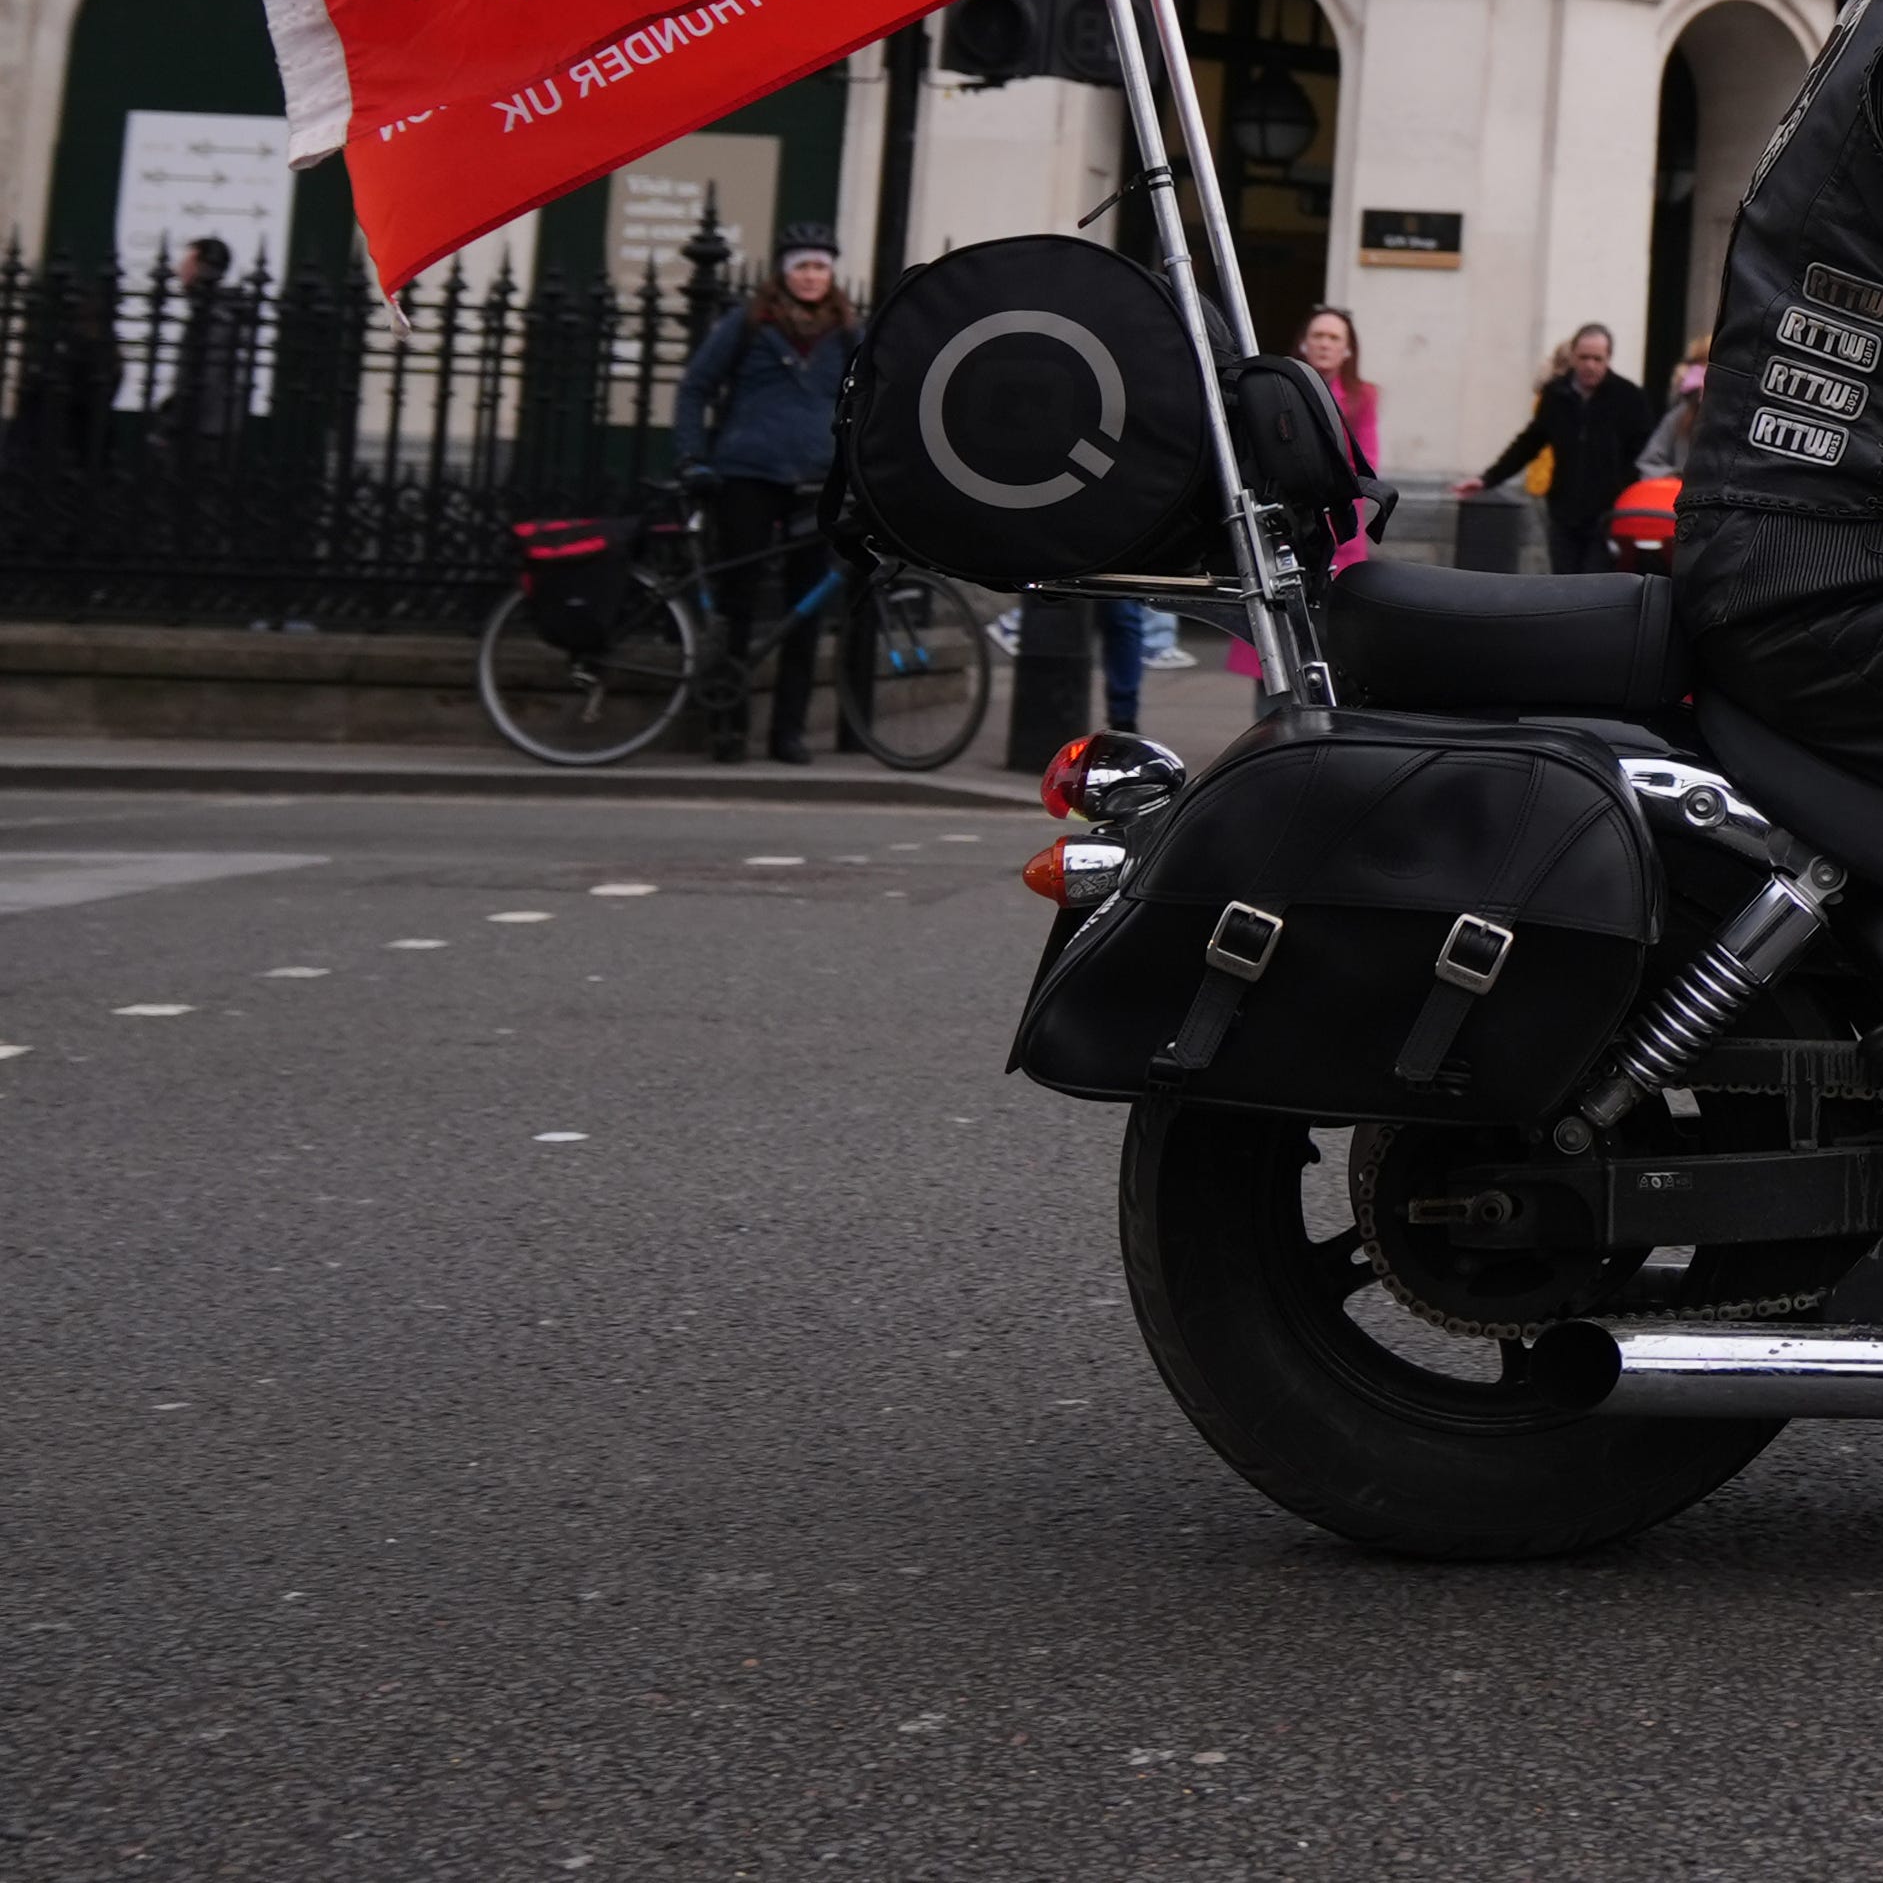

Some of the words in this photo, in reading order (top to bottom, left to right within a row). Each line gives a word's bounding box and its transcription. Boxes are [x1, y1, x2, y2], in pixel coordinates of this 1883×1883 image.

[1783, 312, 1868, 363] RTTW
[1767, 364, 1851, 410] RTTW
[1844, 389, 1860, 413] 2021
[1755, 414, 1834, 457] RTTW
[1826, 433, 1842, 461] 2023
